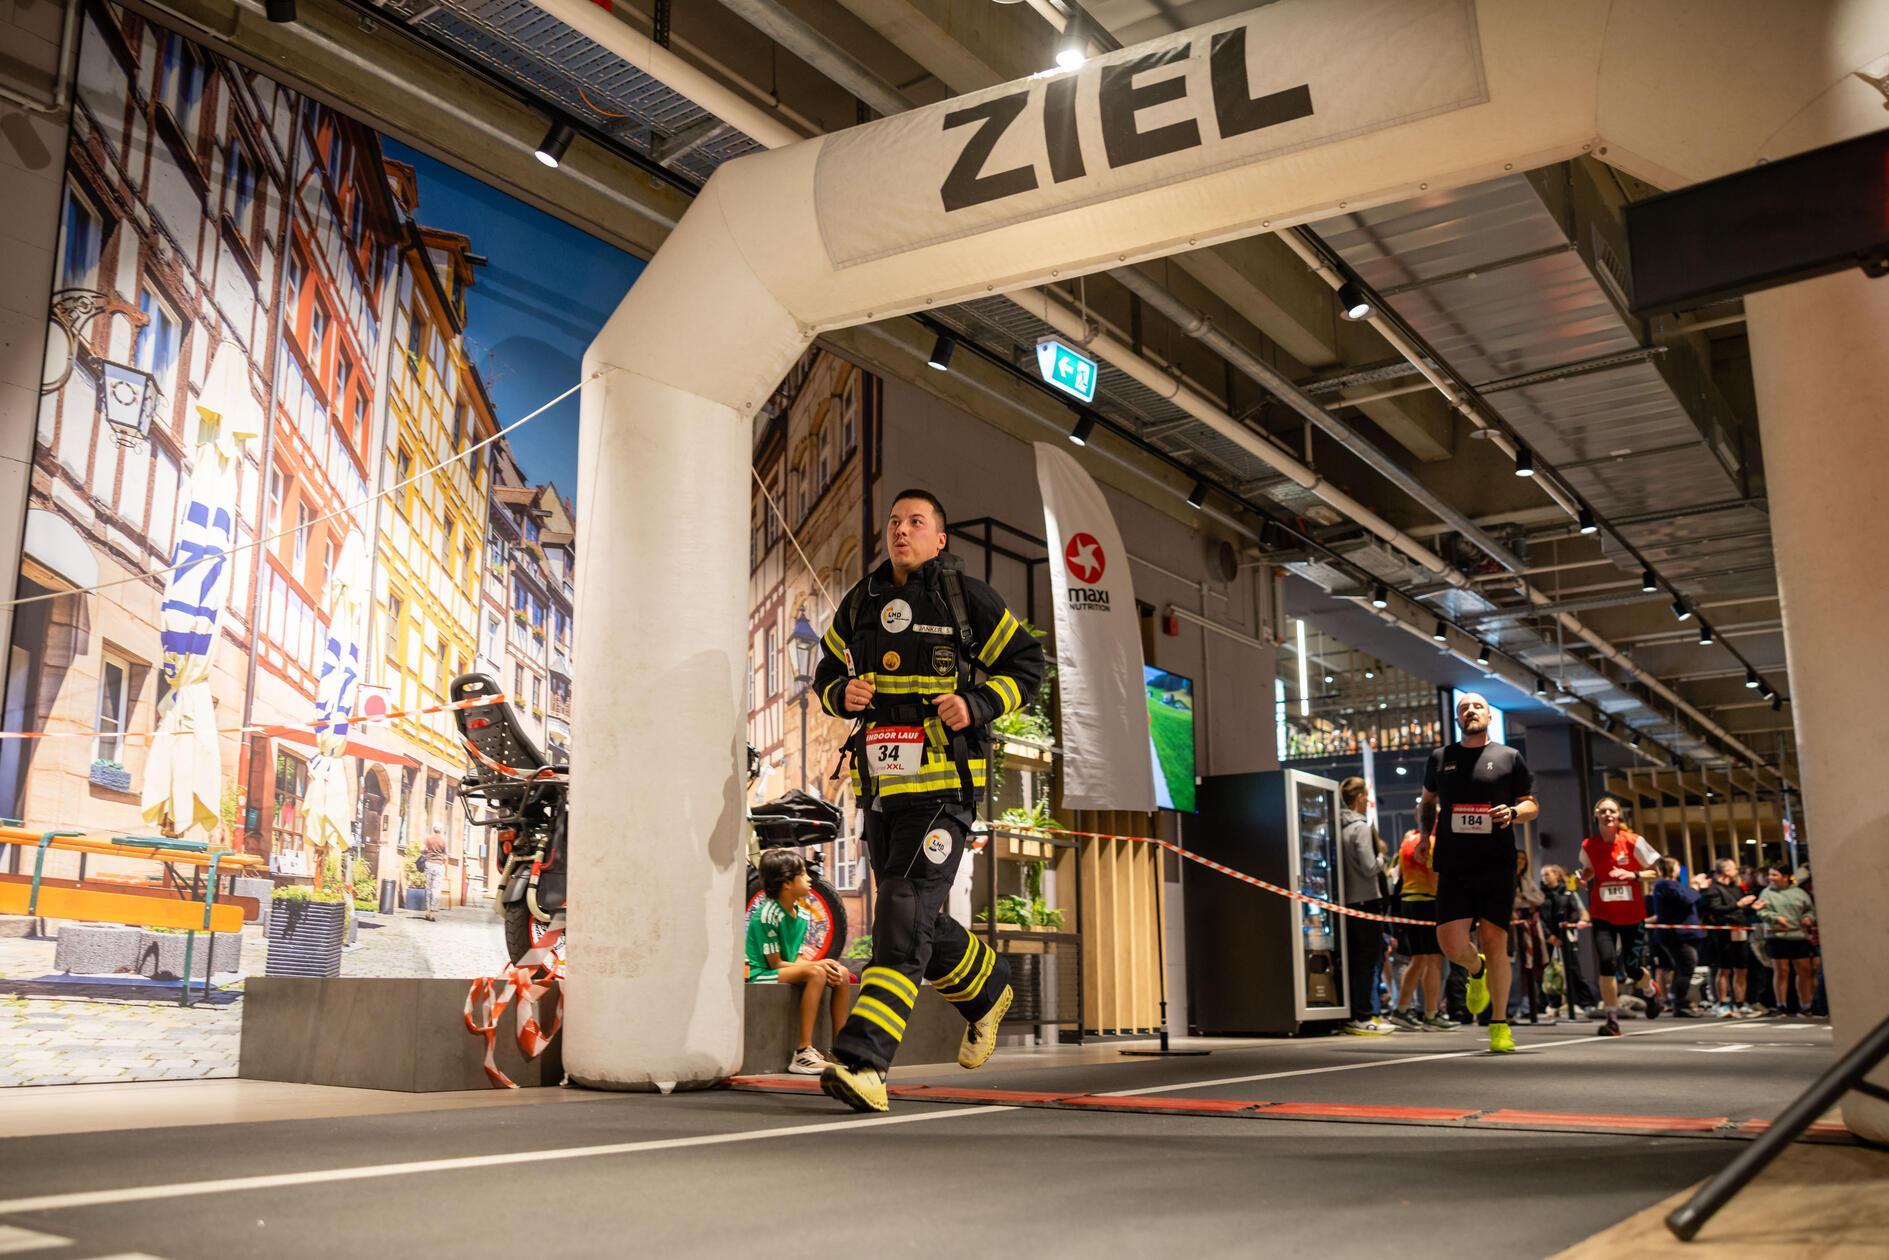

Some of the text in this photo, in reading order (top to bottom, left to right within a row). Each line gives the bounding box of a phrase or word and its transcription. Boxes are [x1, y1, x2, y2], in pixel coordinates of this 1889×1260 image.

[940, 26, 1314, 213] ZIEL
[1068, 587, 1110, 604] maxi
[1069, 602, 1111, 612] NUTRITION
[866, 732, 897, 741] INDOOR
[878, 744, 900, 762] 34
[1461, 815, 1482, 825] 184
